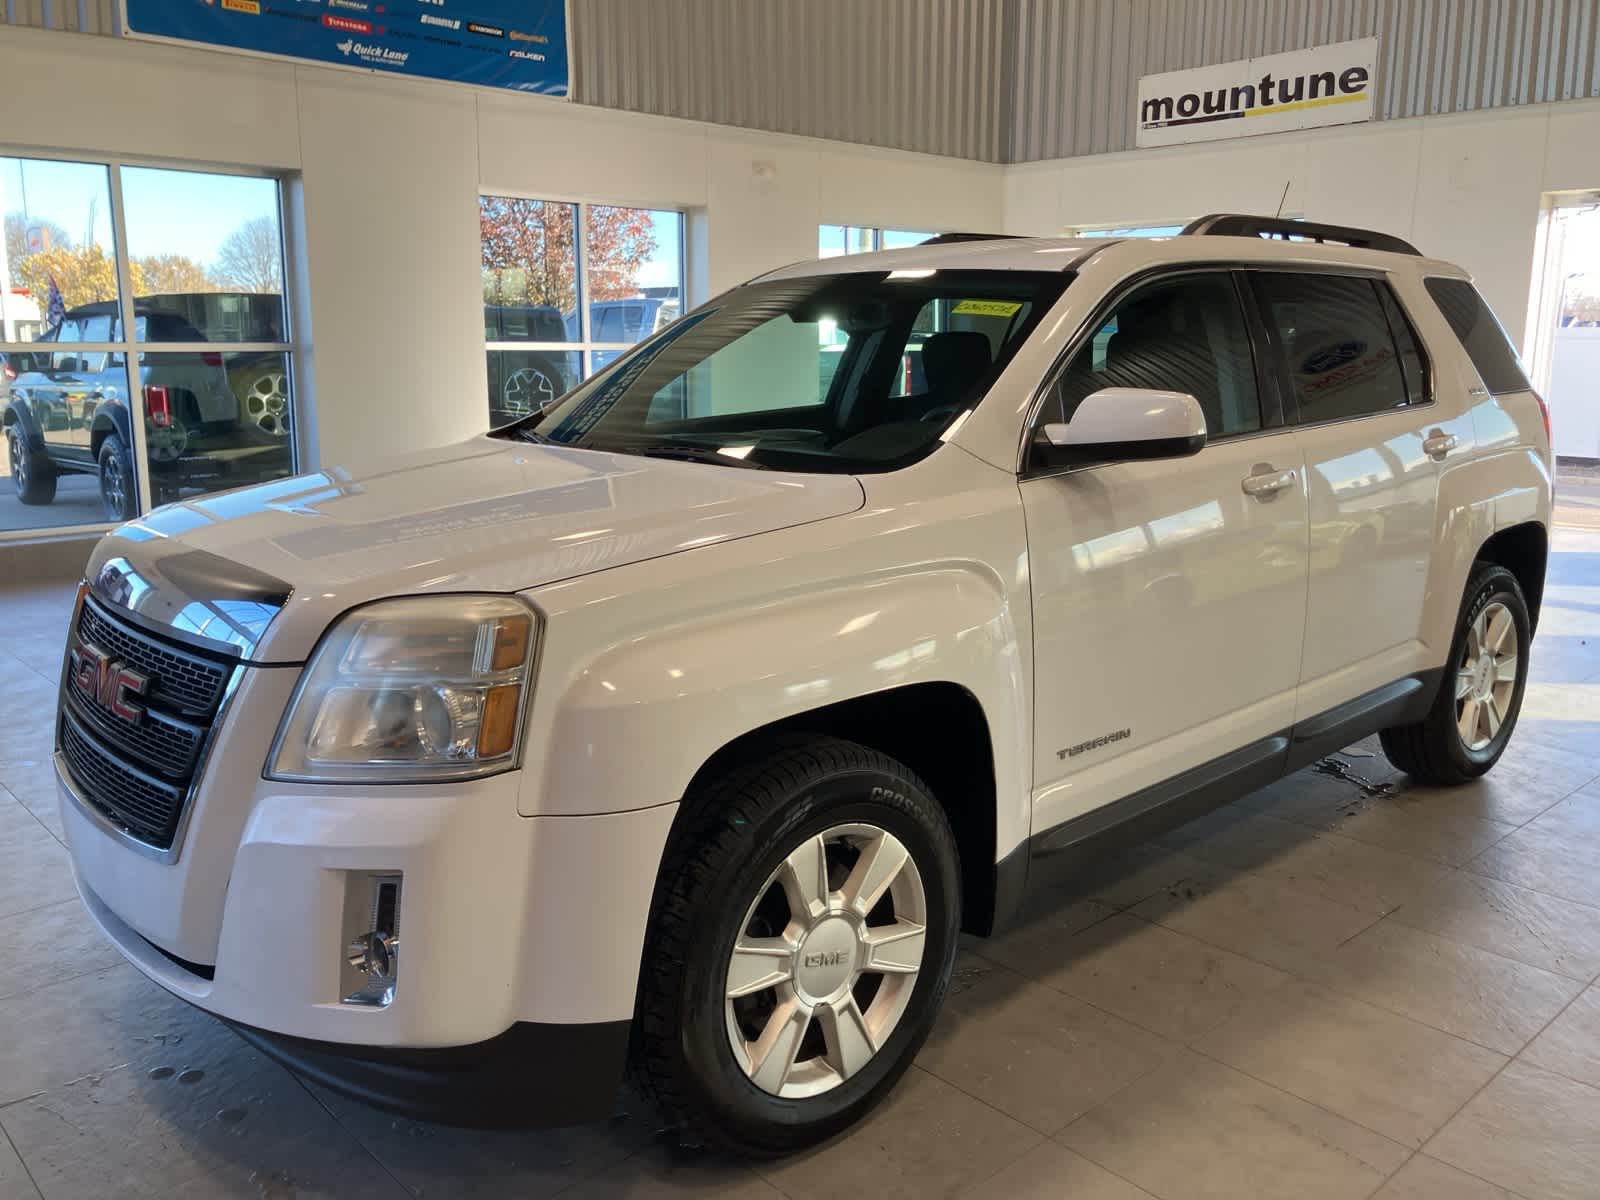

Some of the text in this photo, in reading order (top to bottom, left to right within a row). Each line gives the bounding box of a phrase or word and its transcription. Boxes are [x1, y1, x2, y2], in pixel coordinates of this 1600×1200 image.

[352, 42, 382, 58] Quick
[382, 48, 409, 62] Lane
[1141, 66, 1369, 122] mountune
[72, 643, 150, 725] GMC
[1056, 728, 1131, 761] TERRAIN
[804, 951, 851, 969] GMC
